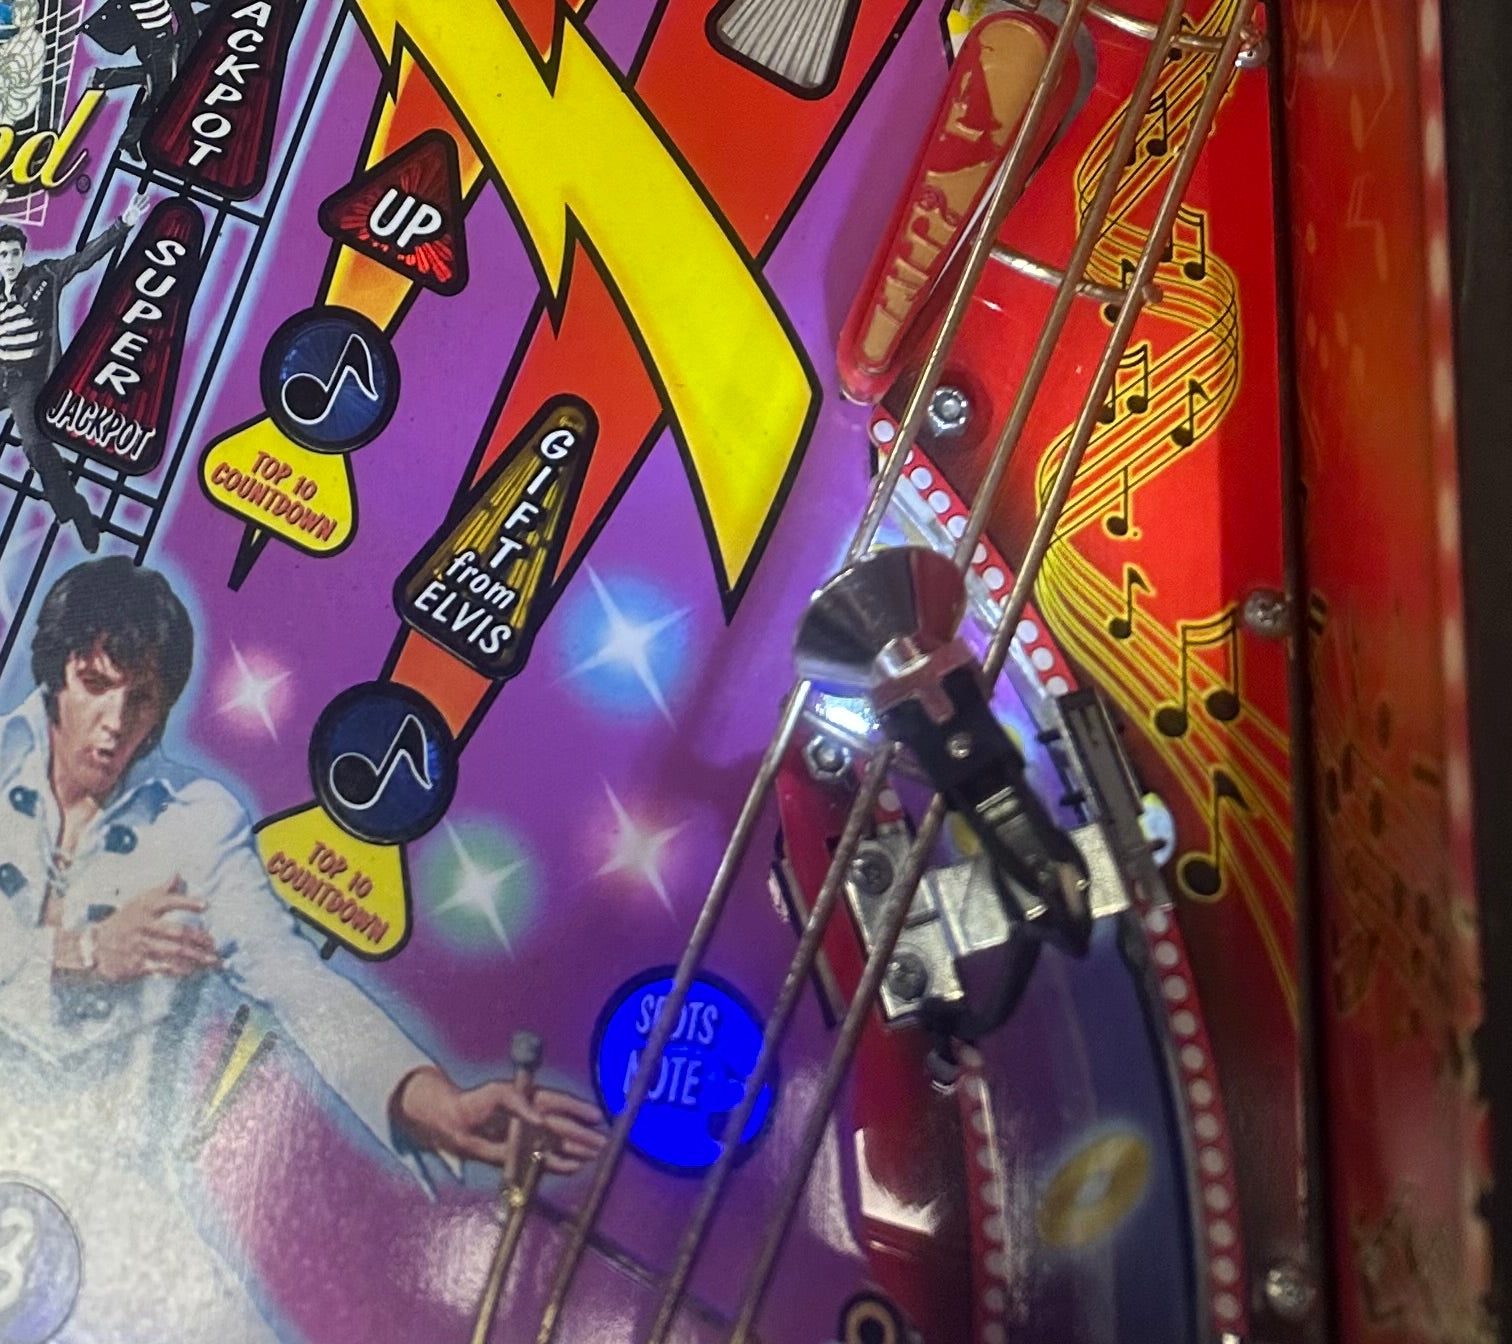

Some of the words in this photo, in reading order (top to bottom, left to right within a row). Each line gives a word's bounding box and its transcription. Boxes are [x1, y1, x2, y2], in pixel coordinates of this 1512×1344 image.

[368, 188, 443, 248] UP
[93, 239, 186, 395] SUPER
[45, 389, 157, 461] JACKPOT
[210, 461, 339, 542] COUNTDOWN
[251, 450, 292, 484] TOP
[289, 477, 319, 502] 10
[488, 429, 576, 569] GIFT
[449, 550, 517, 610] from
[414, 581, 513, 657] ELVIS
[267, 850, 392, 947] COUNTDOWN
[308, 840, 348, 878] TOP
[345, 870, 374, 900] 10
